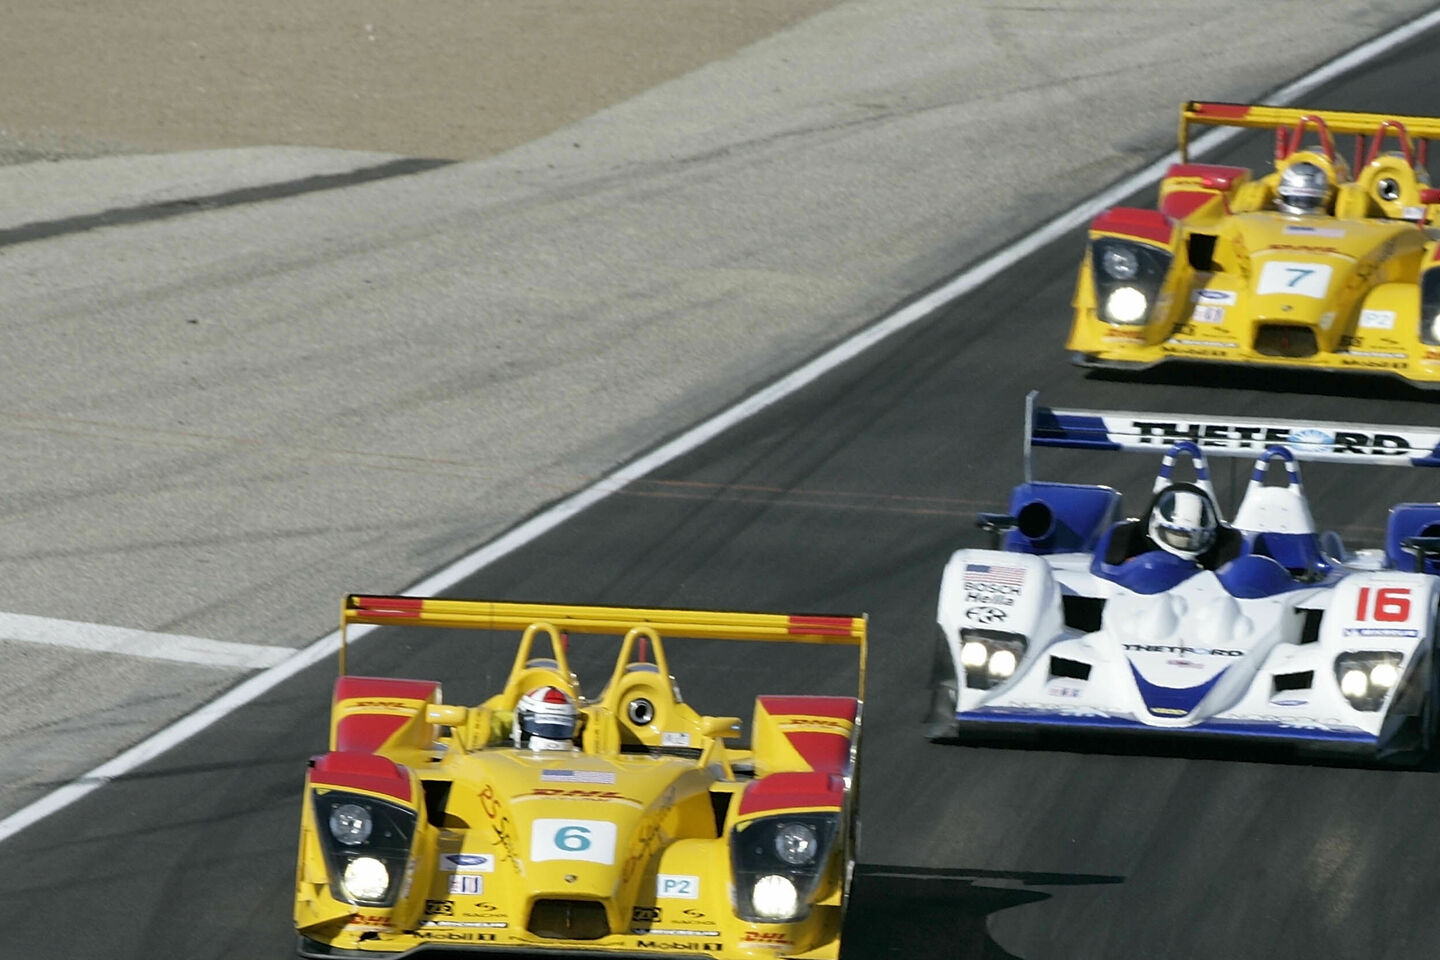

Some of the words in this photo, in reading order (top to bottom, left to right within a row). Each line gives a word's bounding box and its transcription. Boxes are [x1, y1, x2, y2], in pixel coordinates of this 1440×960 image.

[1285, 267, 1317, 288] 7
[1355, 586, 1412, 622] 16
[554, 825, 592, 852] 6
[663, 879, 691, 894] P2
